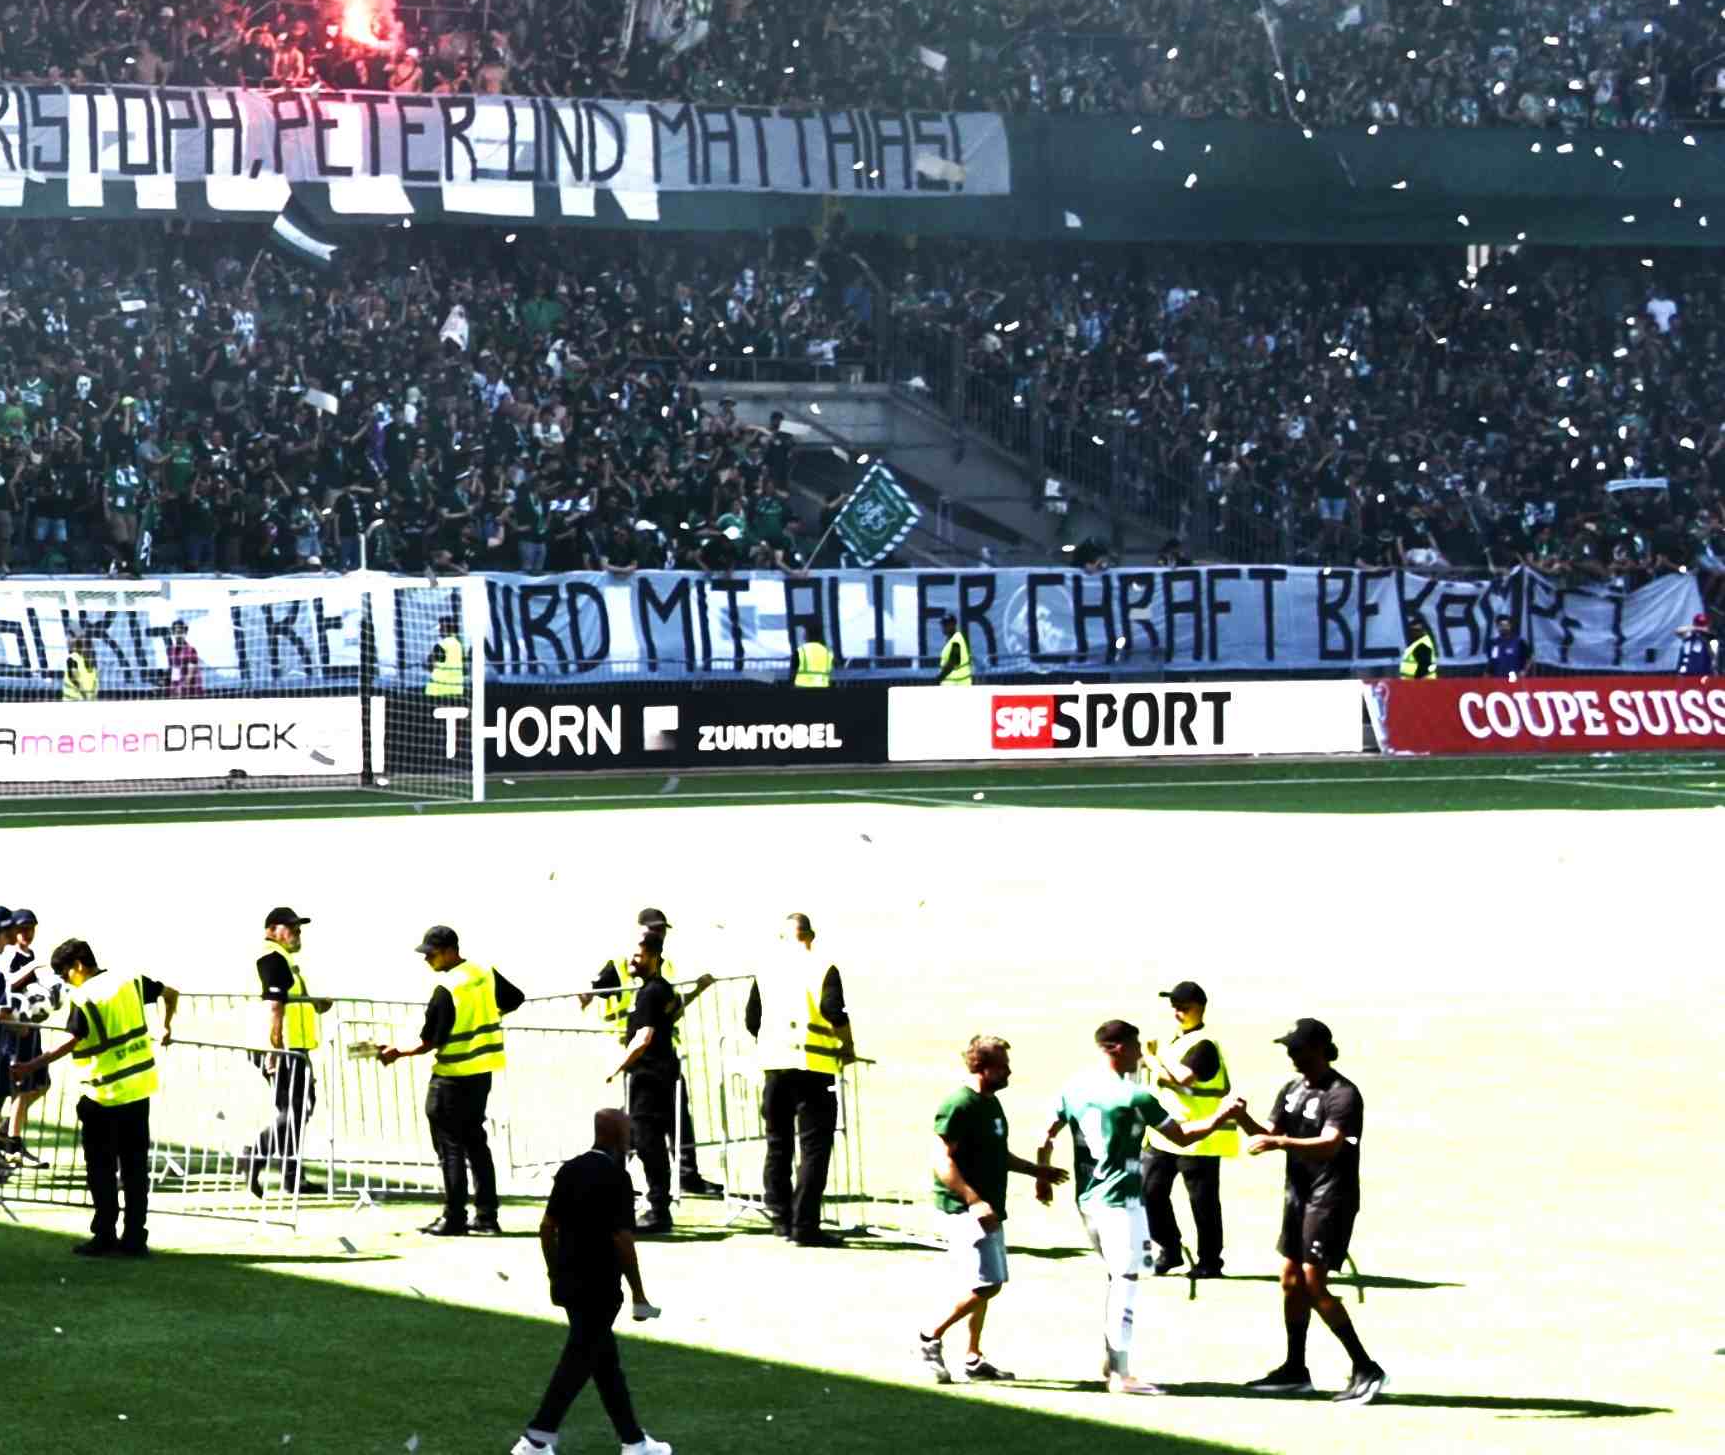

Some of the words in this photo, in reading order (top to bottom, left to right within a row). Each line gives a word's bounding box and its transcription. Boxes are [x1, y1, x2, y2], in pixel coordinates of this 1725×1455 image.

[270, 90, 478, 182] PETER
[505, 97, 625, 183] UND
[637, 576, 750, 674] MIT
[784, 573, 999, 669] ALLER
[1026, 570, 1288, 664] CHRAFT
[433, 703, 622, 759] THORN
[698, 722, 843, 752] ZUMTOBEL
[995, 705, 1049, 738] SRF
[1052, 691, 1232, 749] SPORT
[1458, 689, 1610, 739] COUPE
